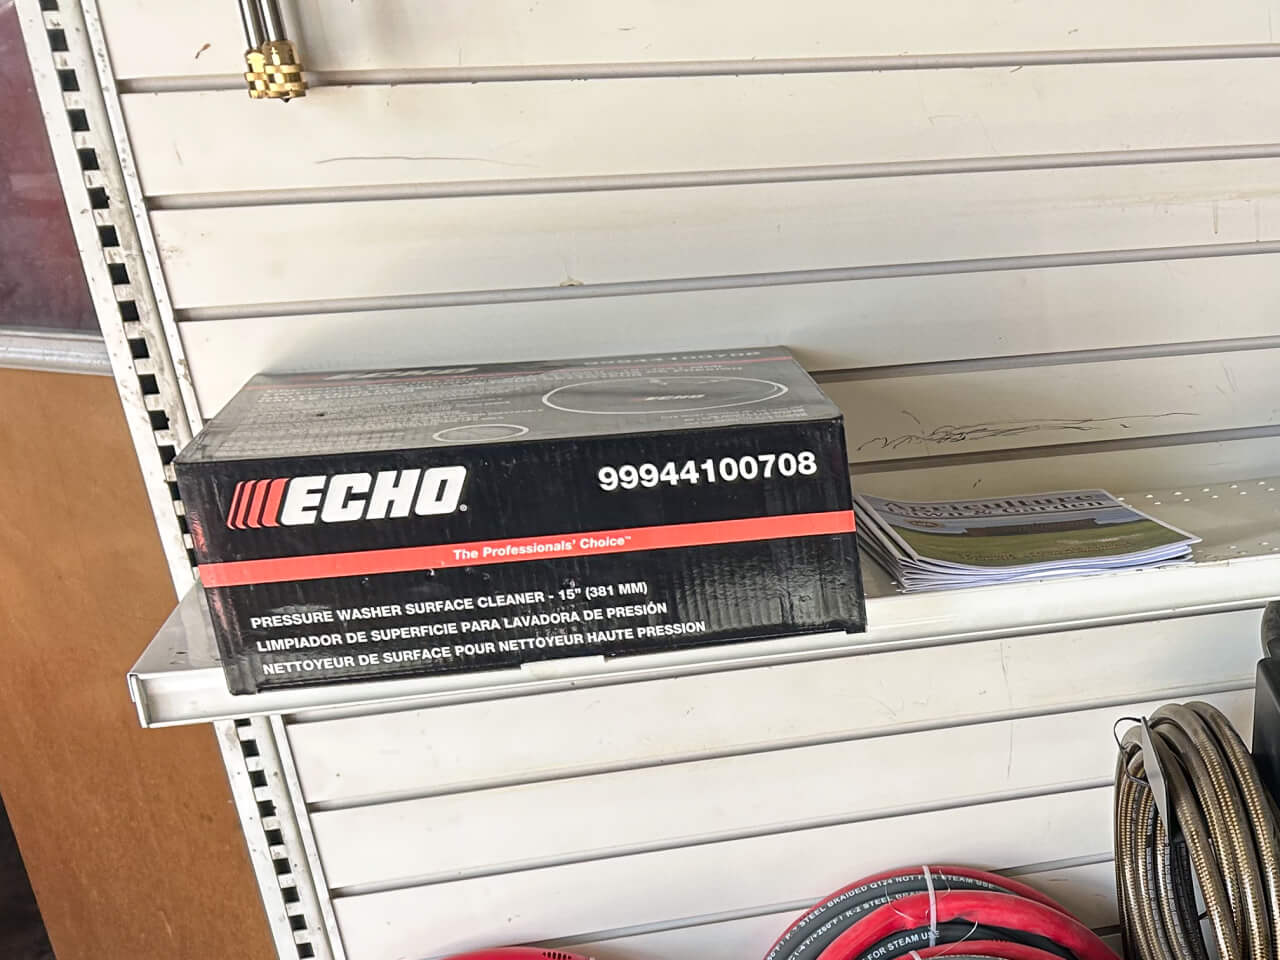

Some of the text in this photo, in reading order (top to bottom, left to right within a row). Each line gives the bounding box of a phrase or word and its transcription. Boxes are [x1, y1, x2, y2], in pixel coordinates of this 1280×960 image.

[598, 450, 818, 493] 99944100708
[281, 466, 467, 526] ECHO
[453, 547, 478, 561] The
[251, 610, 333, 629] PRESSURE
[336, 604, 401, 621] WASHER
[405, 598, 474, 615] SURFACE
[478, 592, 545, 609] CLEANER
[585, 584, 615, 599] (381
[619, 581, 648, 597] MM)
[257, 601, 667, 653] LIMPIADOR DE SUPERFICIE PARA LAVADORA DE PRESIÓN
[263, 621, 706, 675] NETTOYEUR DE SURFACE POUR NETTOYEUR HAUTE PRESSION
[888, 930, 919, 951] STEAM
